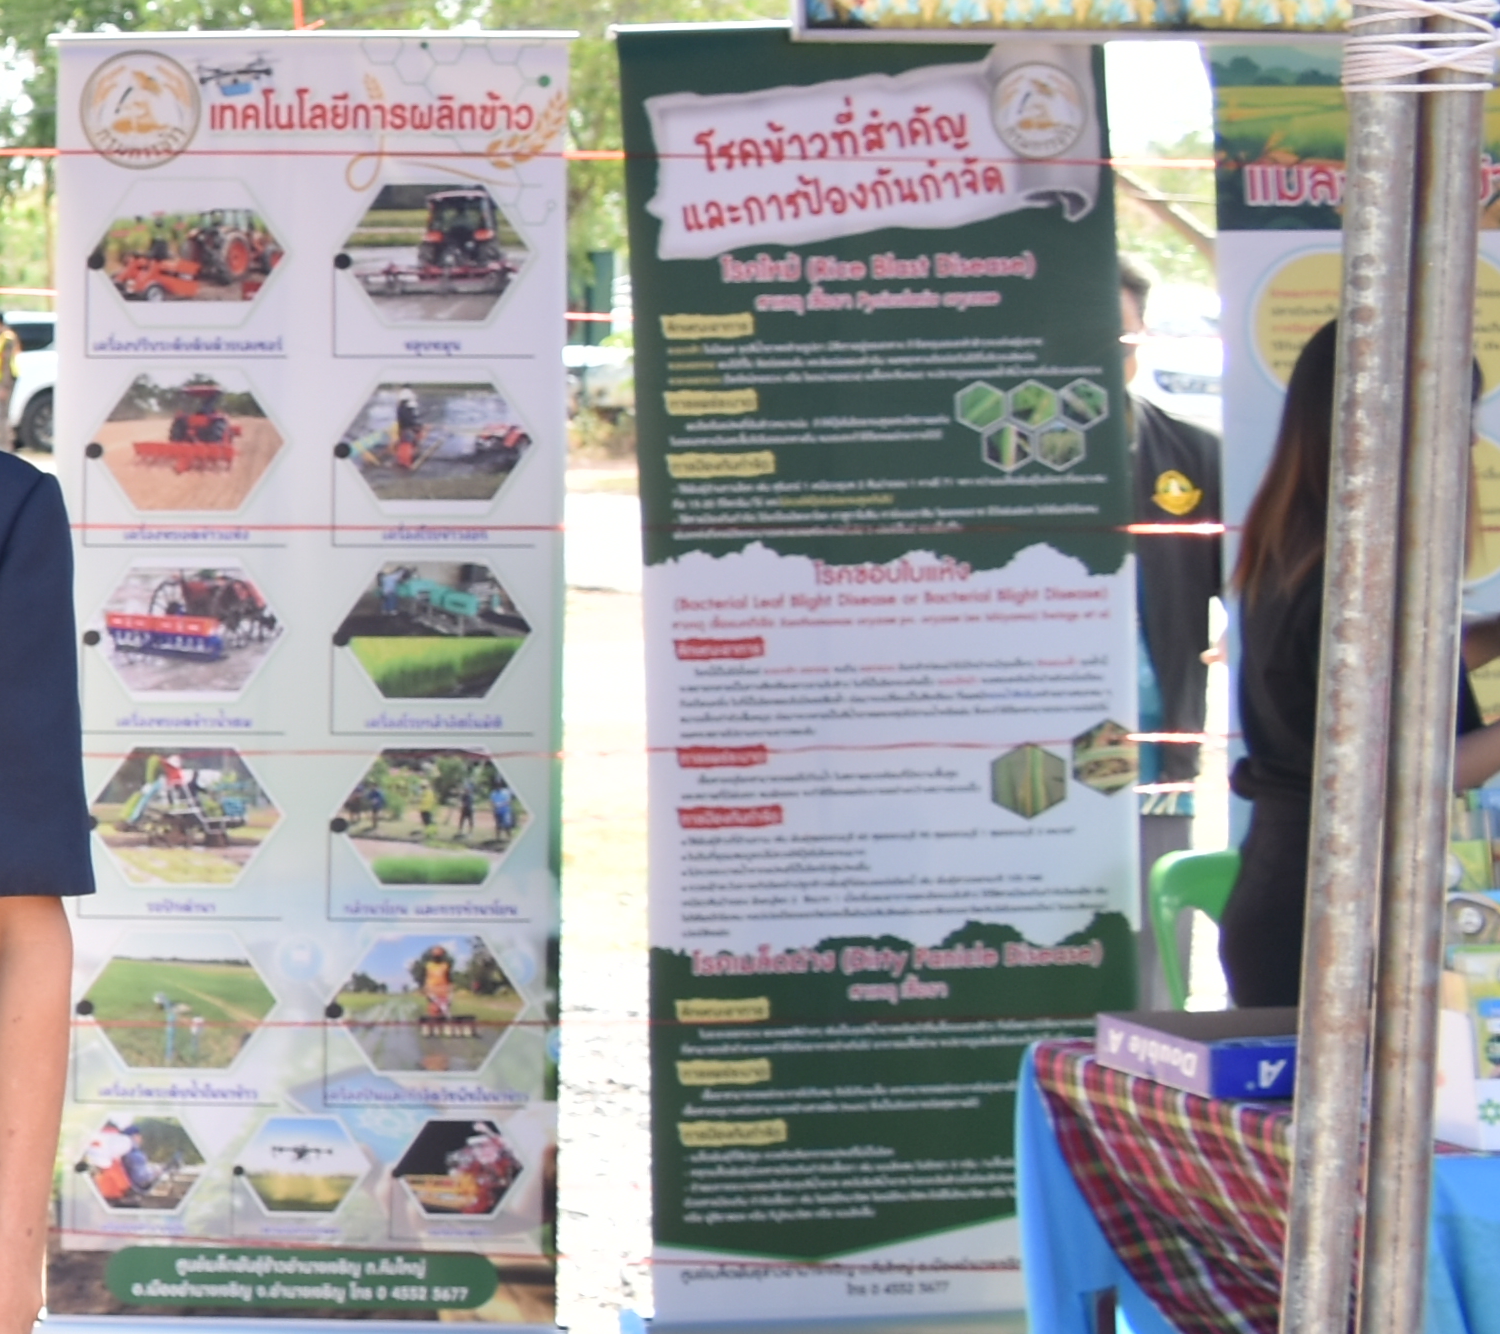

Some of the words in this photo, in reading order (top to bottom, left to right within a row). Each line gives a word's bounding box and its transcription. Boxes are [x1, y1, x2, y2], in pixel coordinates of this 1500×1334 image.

[210, 88, 535, 133] เทคโนโลยีการผลิตข้าว
[695, 97, 970, 173] โรคข้าวที่สำคัญ
[682, 157, 1006, 233] และการป้องกันกำจัด
[1107, 1028, 1124, 1054] A
[1127, 1034, 1199, 1078] Double
